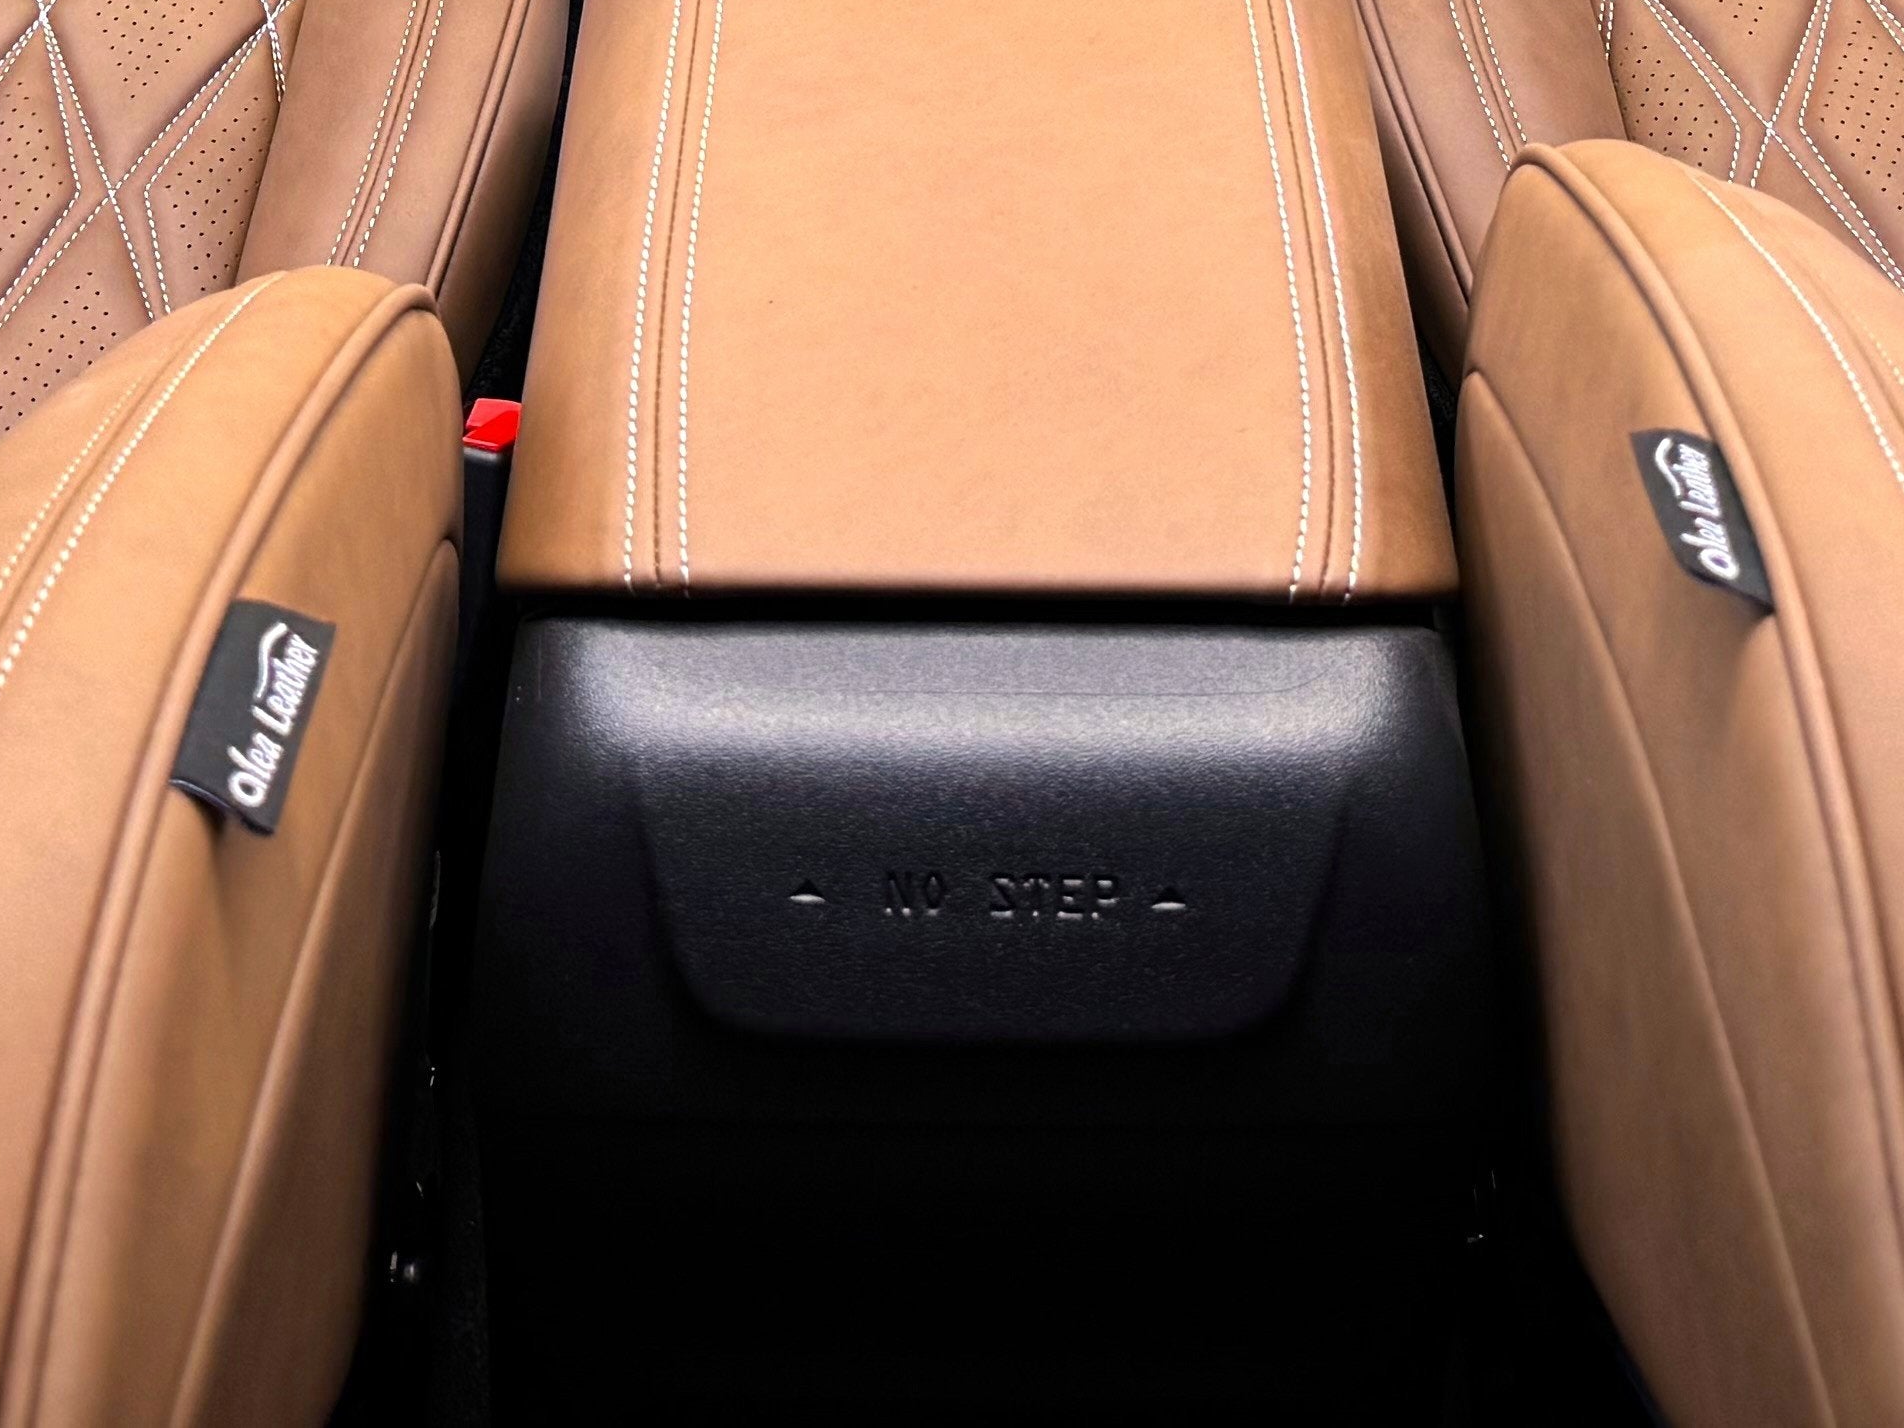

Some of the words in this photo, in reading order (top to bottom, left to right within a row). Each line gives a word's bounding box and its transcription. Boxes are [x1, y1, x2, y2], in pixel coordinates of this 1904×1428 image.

[1673, 443, 1722, 519] Leather
[1680, 516, 1739, 581] Olea
[251, 633, 320, 736] Leather
[226, 728, 285, 809] Olea
[884, 875, 942, 918] NO
[989, 875, 1120, 921] STEP
